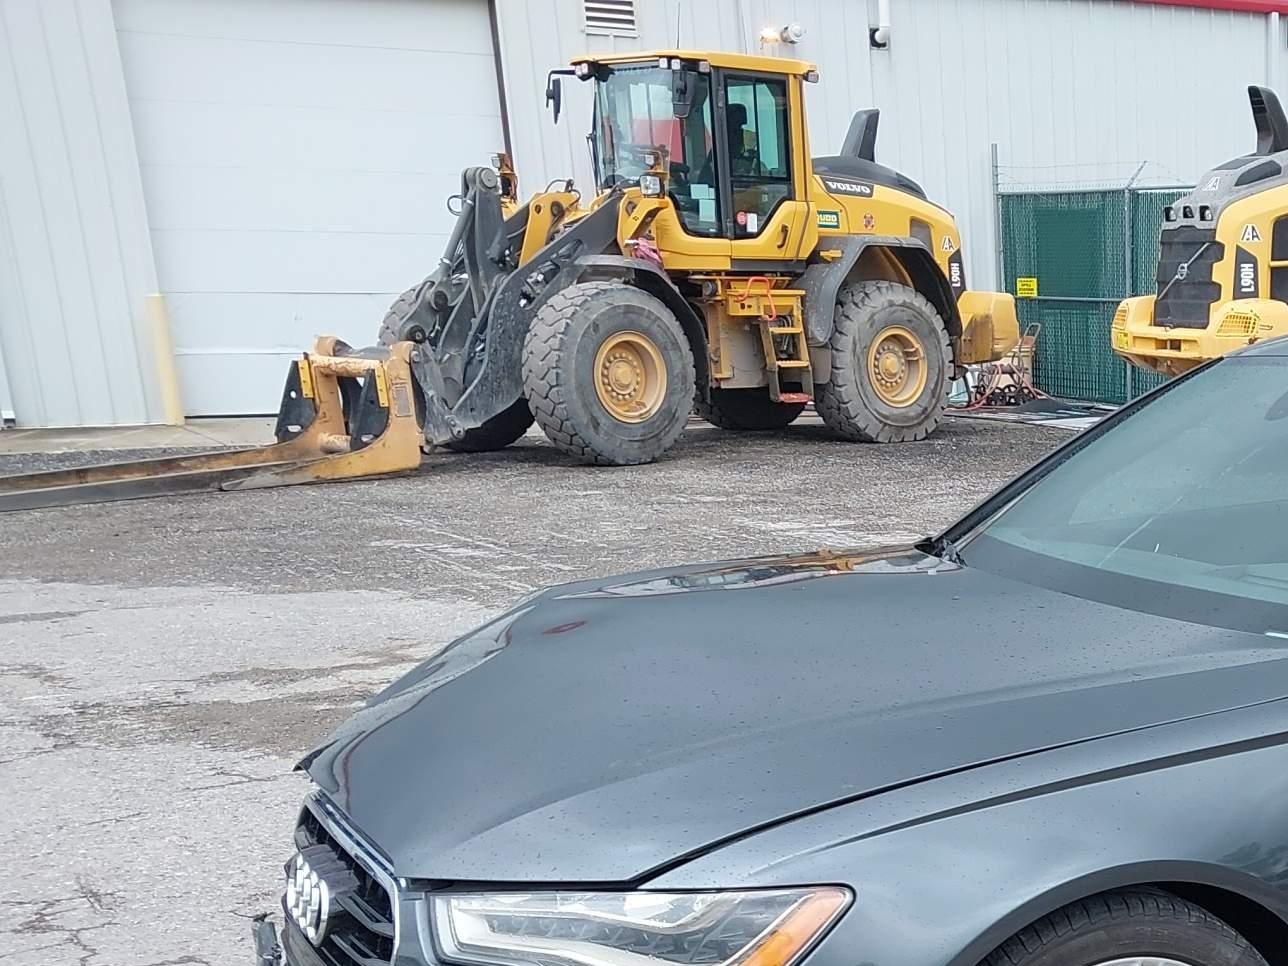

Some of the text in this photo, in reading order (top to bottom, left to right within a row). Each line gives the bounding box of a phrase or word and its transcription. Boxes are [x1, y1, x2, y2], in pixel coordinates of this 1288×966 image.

[826, 180, 871, 194] VOLVO
[950, 262, 961, 288] L90H
[1241, 263, 1255, 292] L90H
